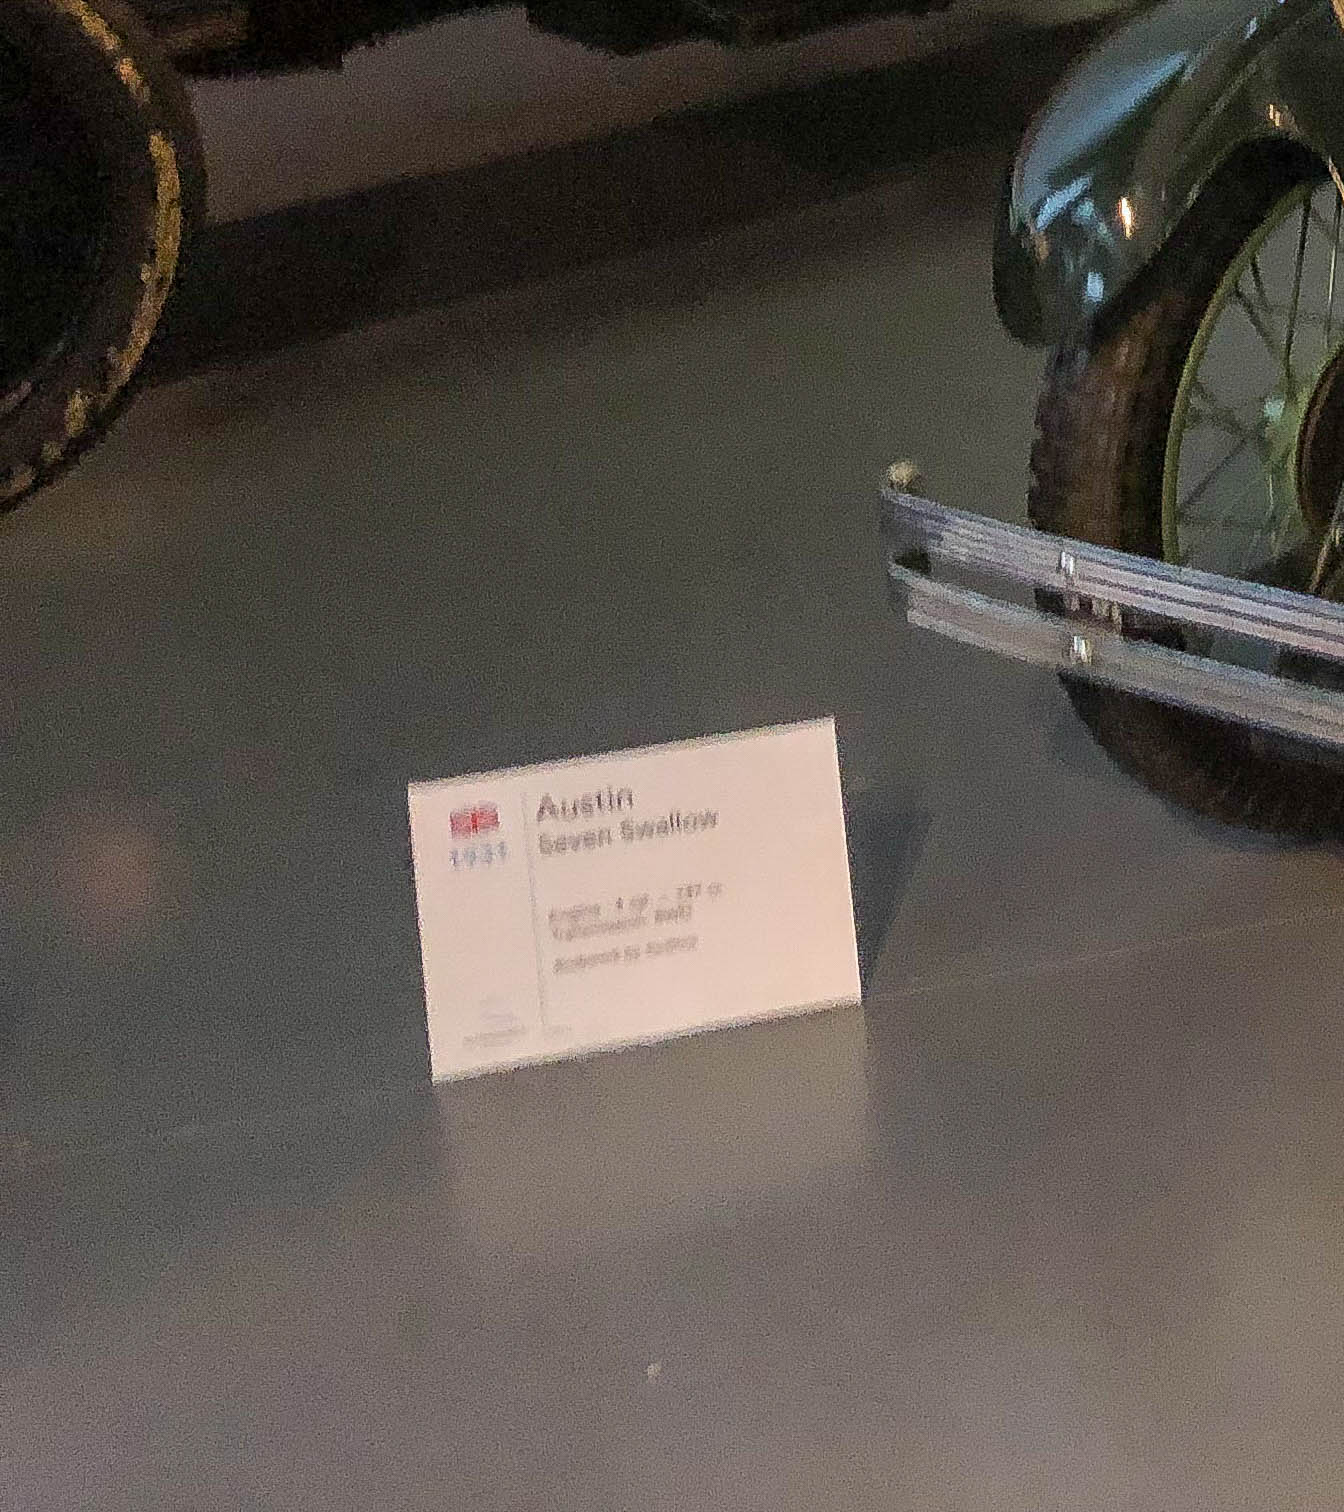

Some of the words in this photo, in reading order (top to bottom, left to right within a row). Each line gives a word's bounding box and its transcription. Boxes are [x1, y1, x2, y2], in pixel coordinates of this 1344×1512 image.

[537, 785, 633, 822] Austin
[538, 828, 612, 856] Seven
[620, 808, 720, 841] Swallow
